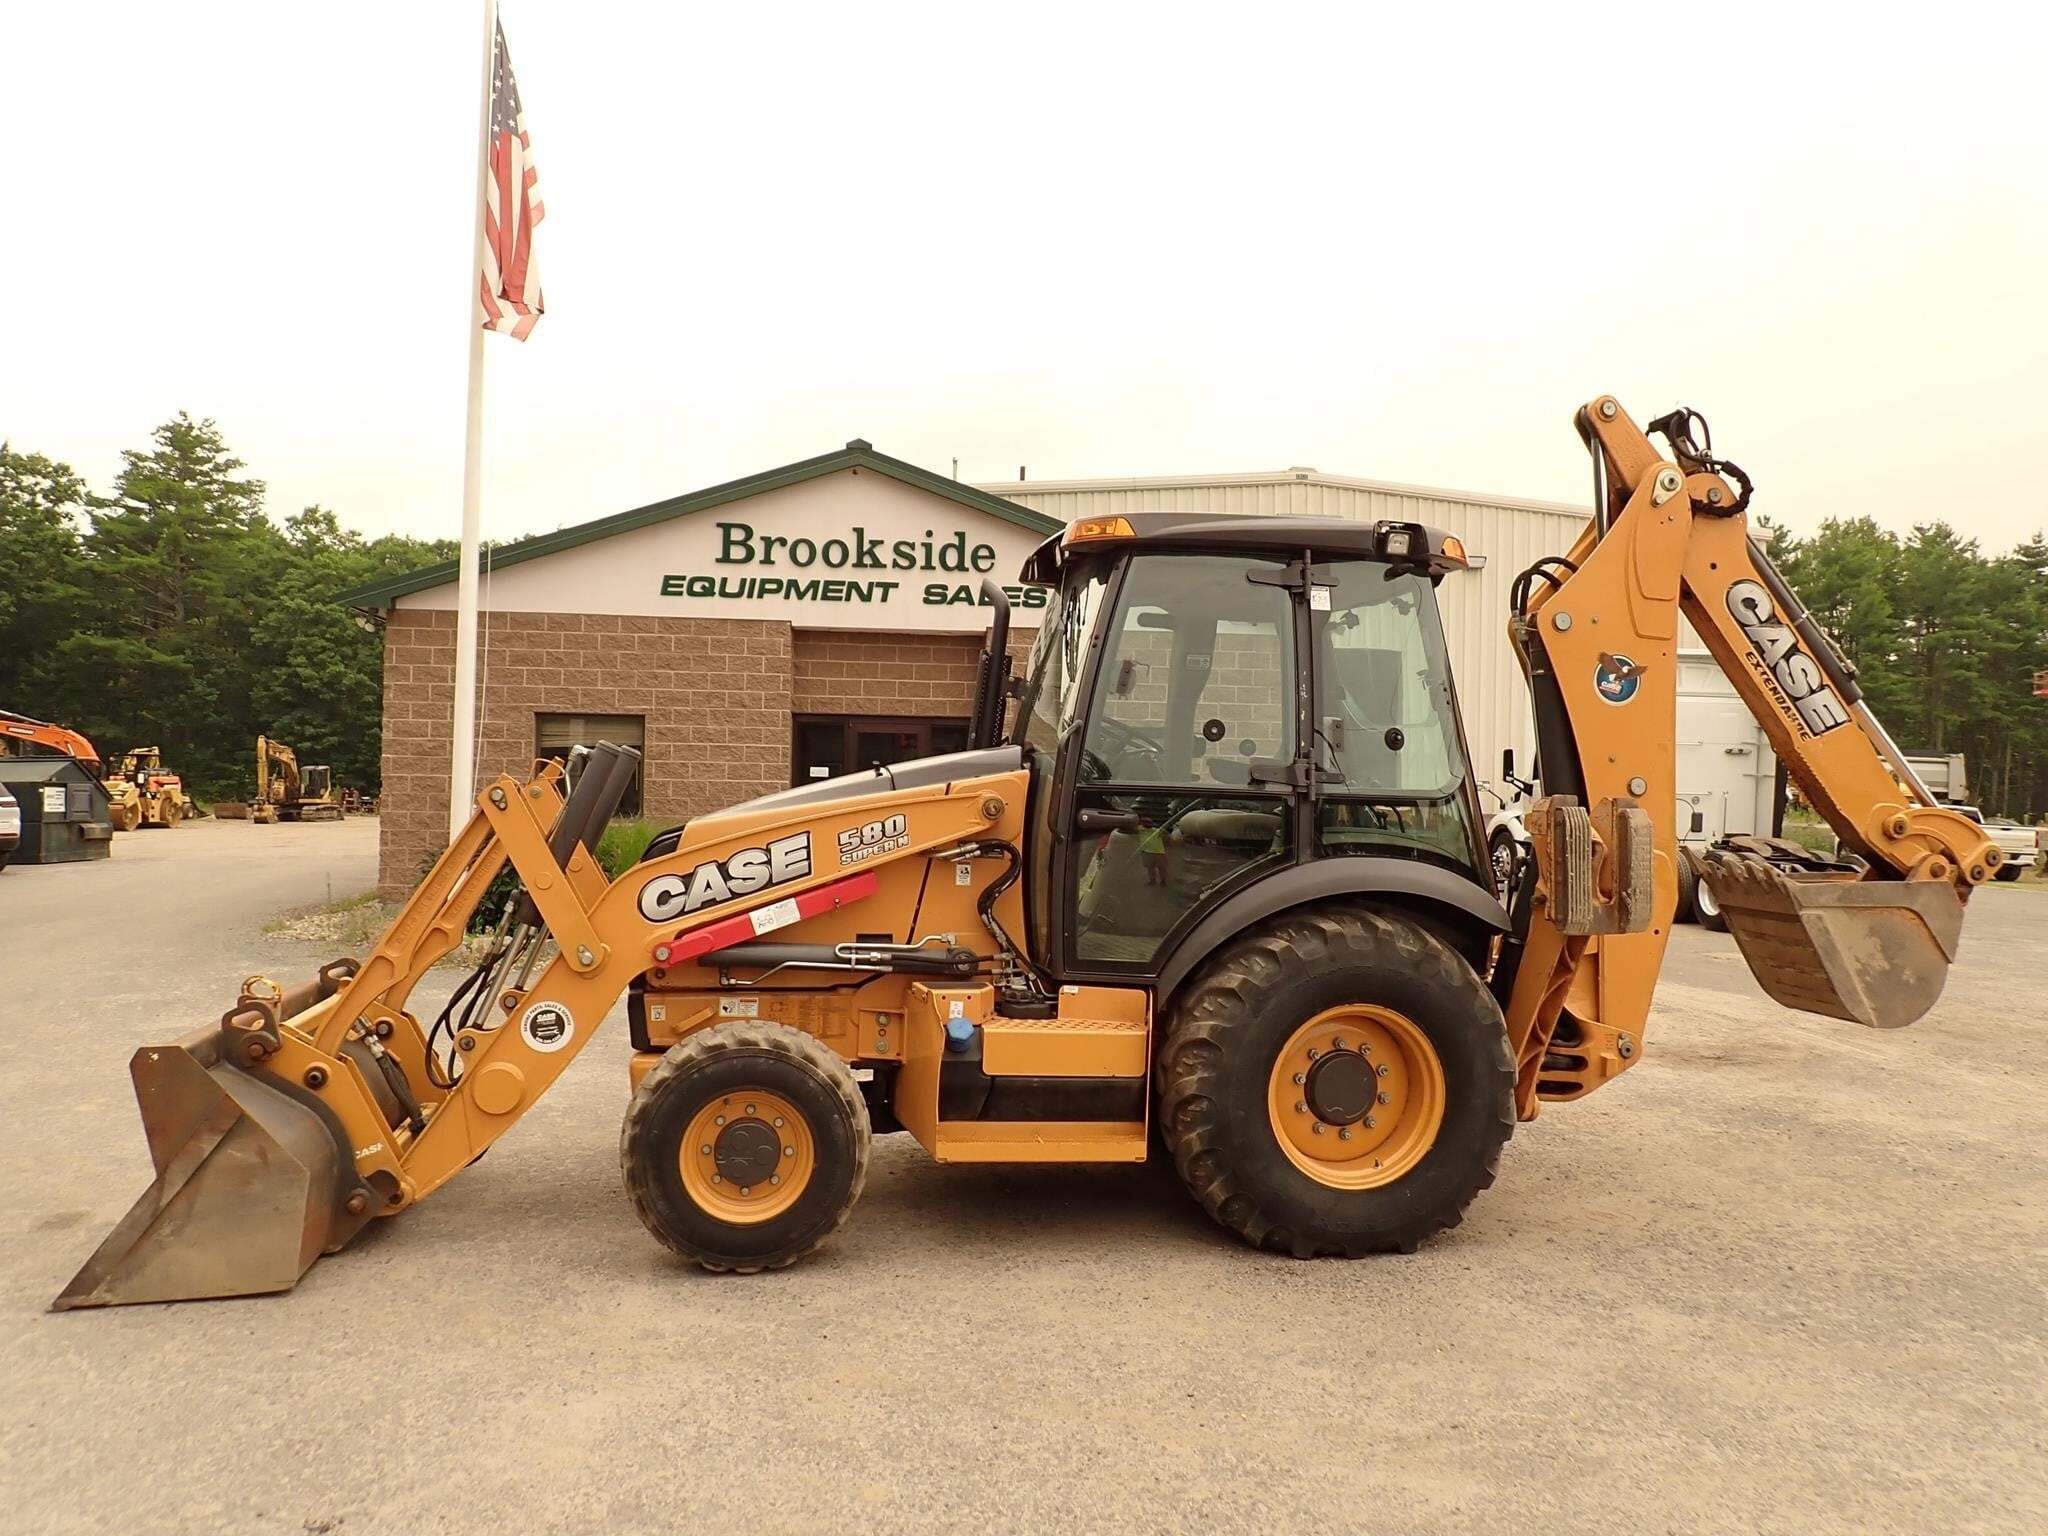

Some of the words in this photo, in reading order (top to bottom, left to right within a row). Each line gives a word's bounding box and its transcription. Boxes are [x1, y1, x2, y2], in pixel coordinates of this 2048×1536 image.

[715, 522, 995, 572] Brookside
[660, 574, 900, 602] EQUIPMENT
[1727, 580, 1850, 735] CASE
[838, 814, 906, 853] 580
[840, 840, 895, 866] SUPER
[896, 834, 909, 848] N
[640, 832, 812, 922] CASE
